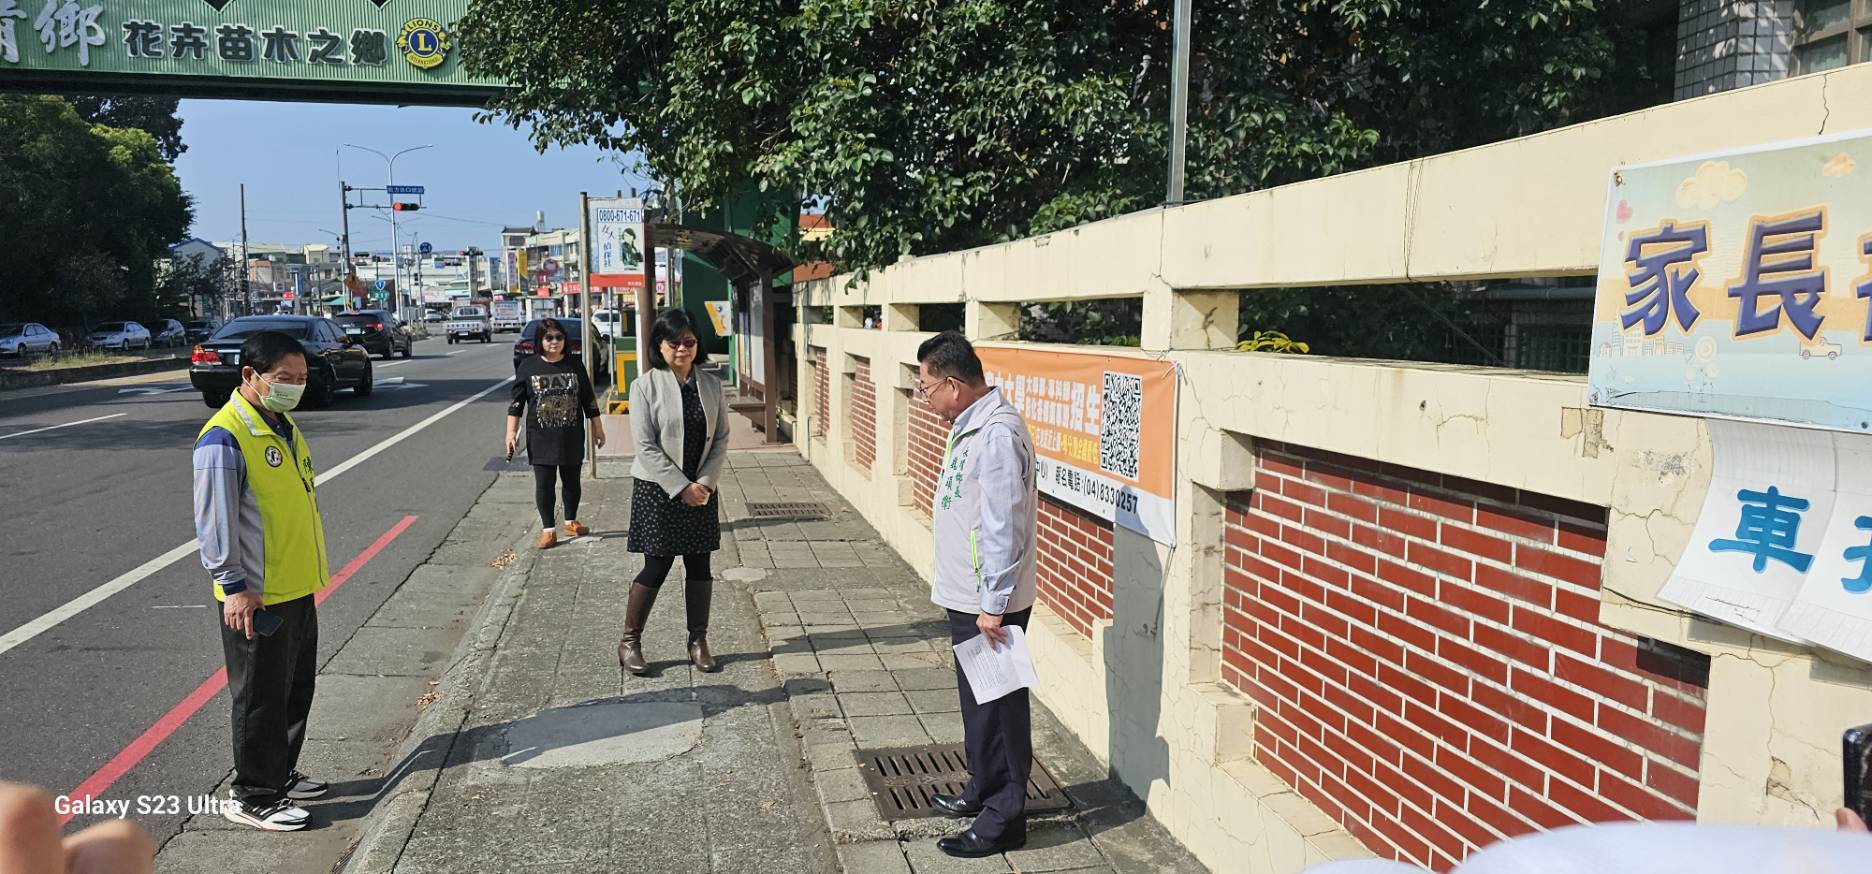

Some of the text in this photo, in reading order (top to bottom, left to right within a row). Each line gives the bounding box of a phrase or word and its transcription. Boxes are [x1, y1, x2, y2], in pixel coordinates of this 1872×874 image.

[407, 20, 439, 31] LIONS
[121, 19, 388, 66] 花卉苗木之鄉
[417, 33, 432, 51] L
[599, 209, 640, 221] 0800-671-671
[1620, 205, 1872, 342] 家長
